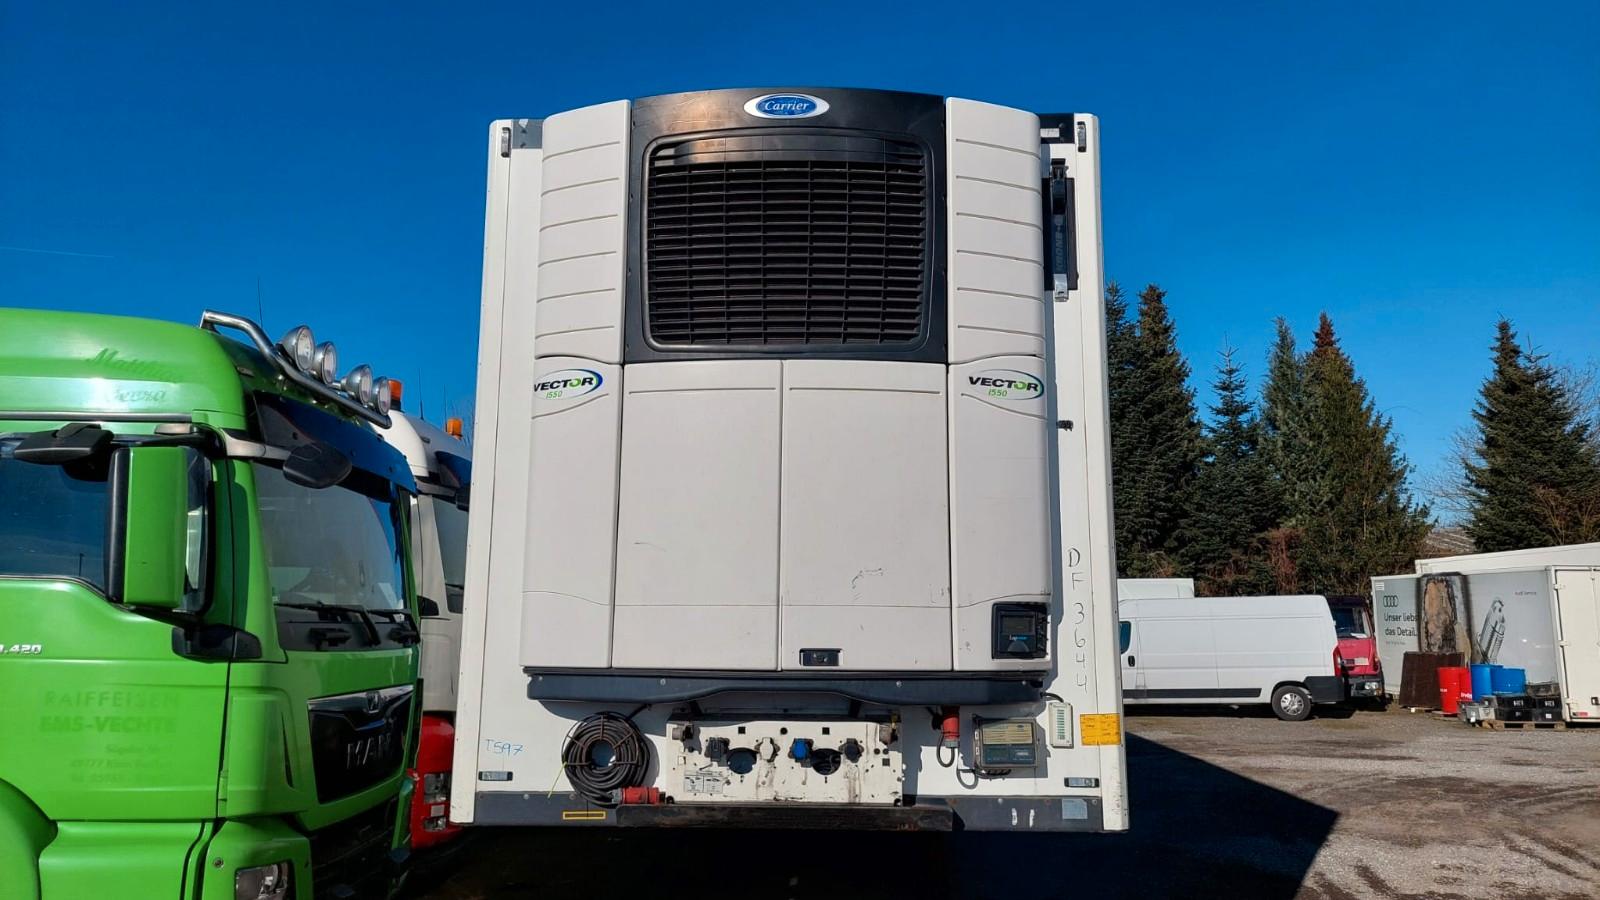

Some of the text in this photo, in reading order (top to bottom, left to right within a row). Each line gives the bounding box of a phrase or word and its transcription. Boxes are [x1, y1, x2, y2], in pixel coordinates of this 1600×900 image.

[765, 100, 809, 111] Carrier
[533, 377, 594, 392] VECTOR
[969, 376, 1039, 392] VECTOR
[1384, 612, 1402, 622] Unser
[1385, 627, 1396, 636] das
